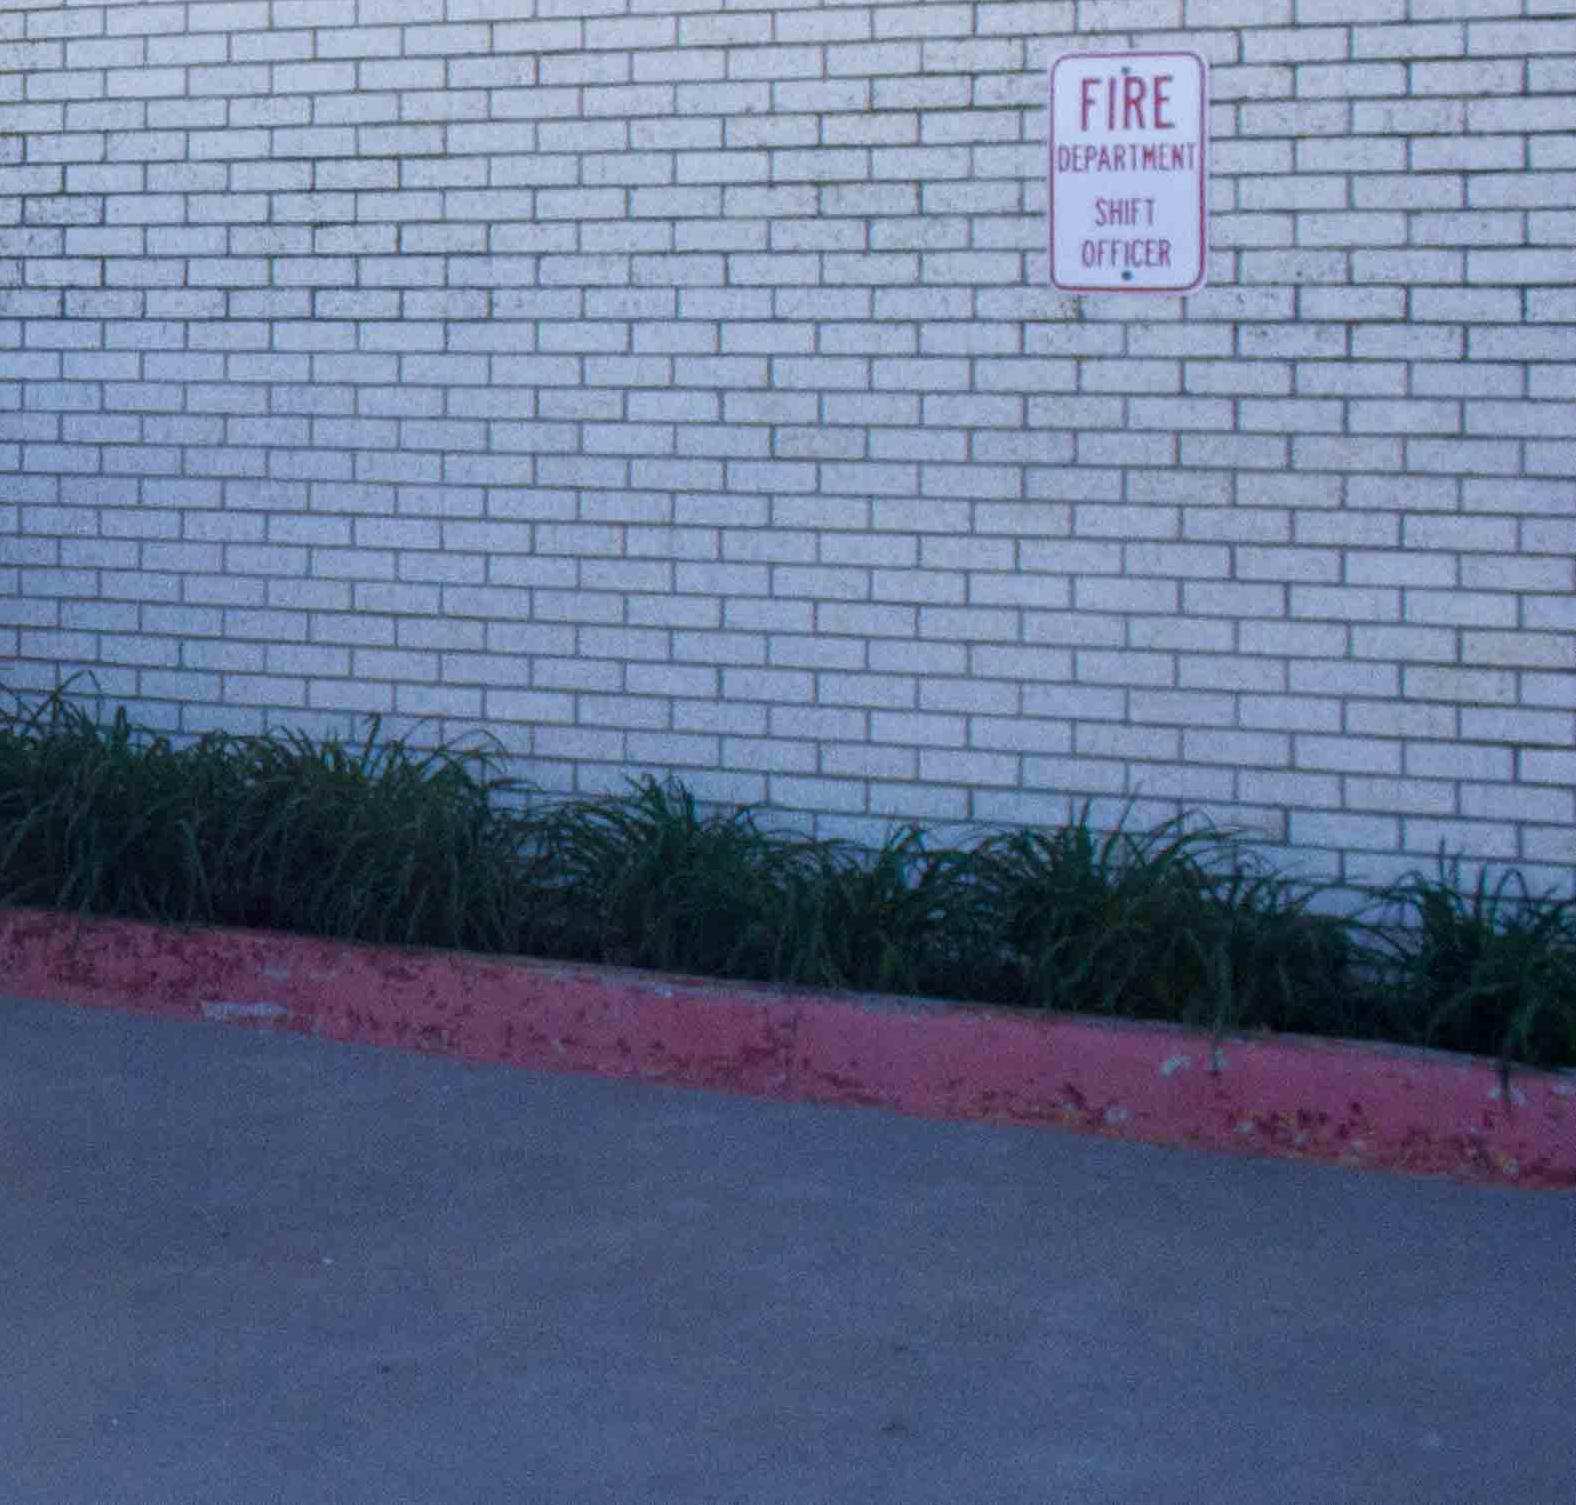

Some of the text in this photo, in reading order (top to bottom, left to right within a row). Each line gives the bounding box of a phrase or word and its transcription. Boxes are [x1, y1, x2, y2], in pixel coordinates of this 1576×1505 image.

[1080, 74, 1176, 132] FIRE
[1057, 141, 1197, 174] DEPARTMENT
[1094, 197, 1156, 227] SHIFT
[1080, 238, 1173, 269] OFFICER
